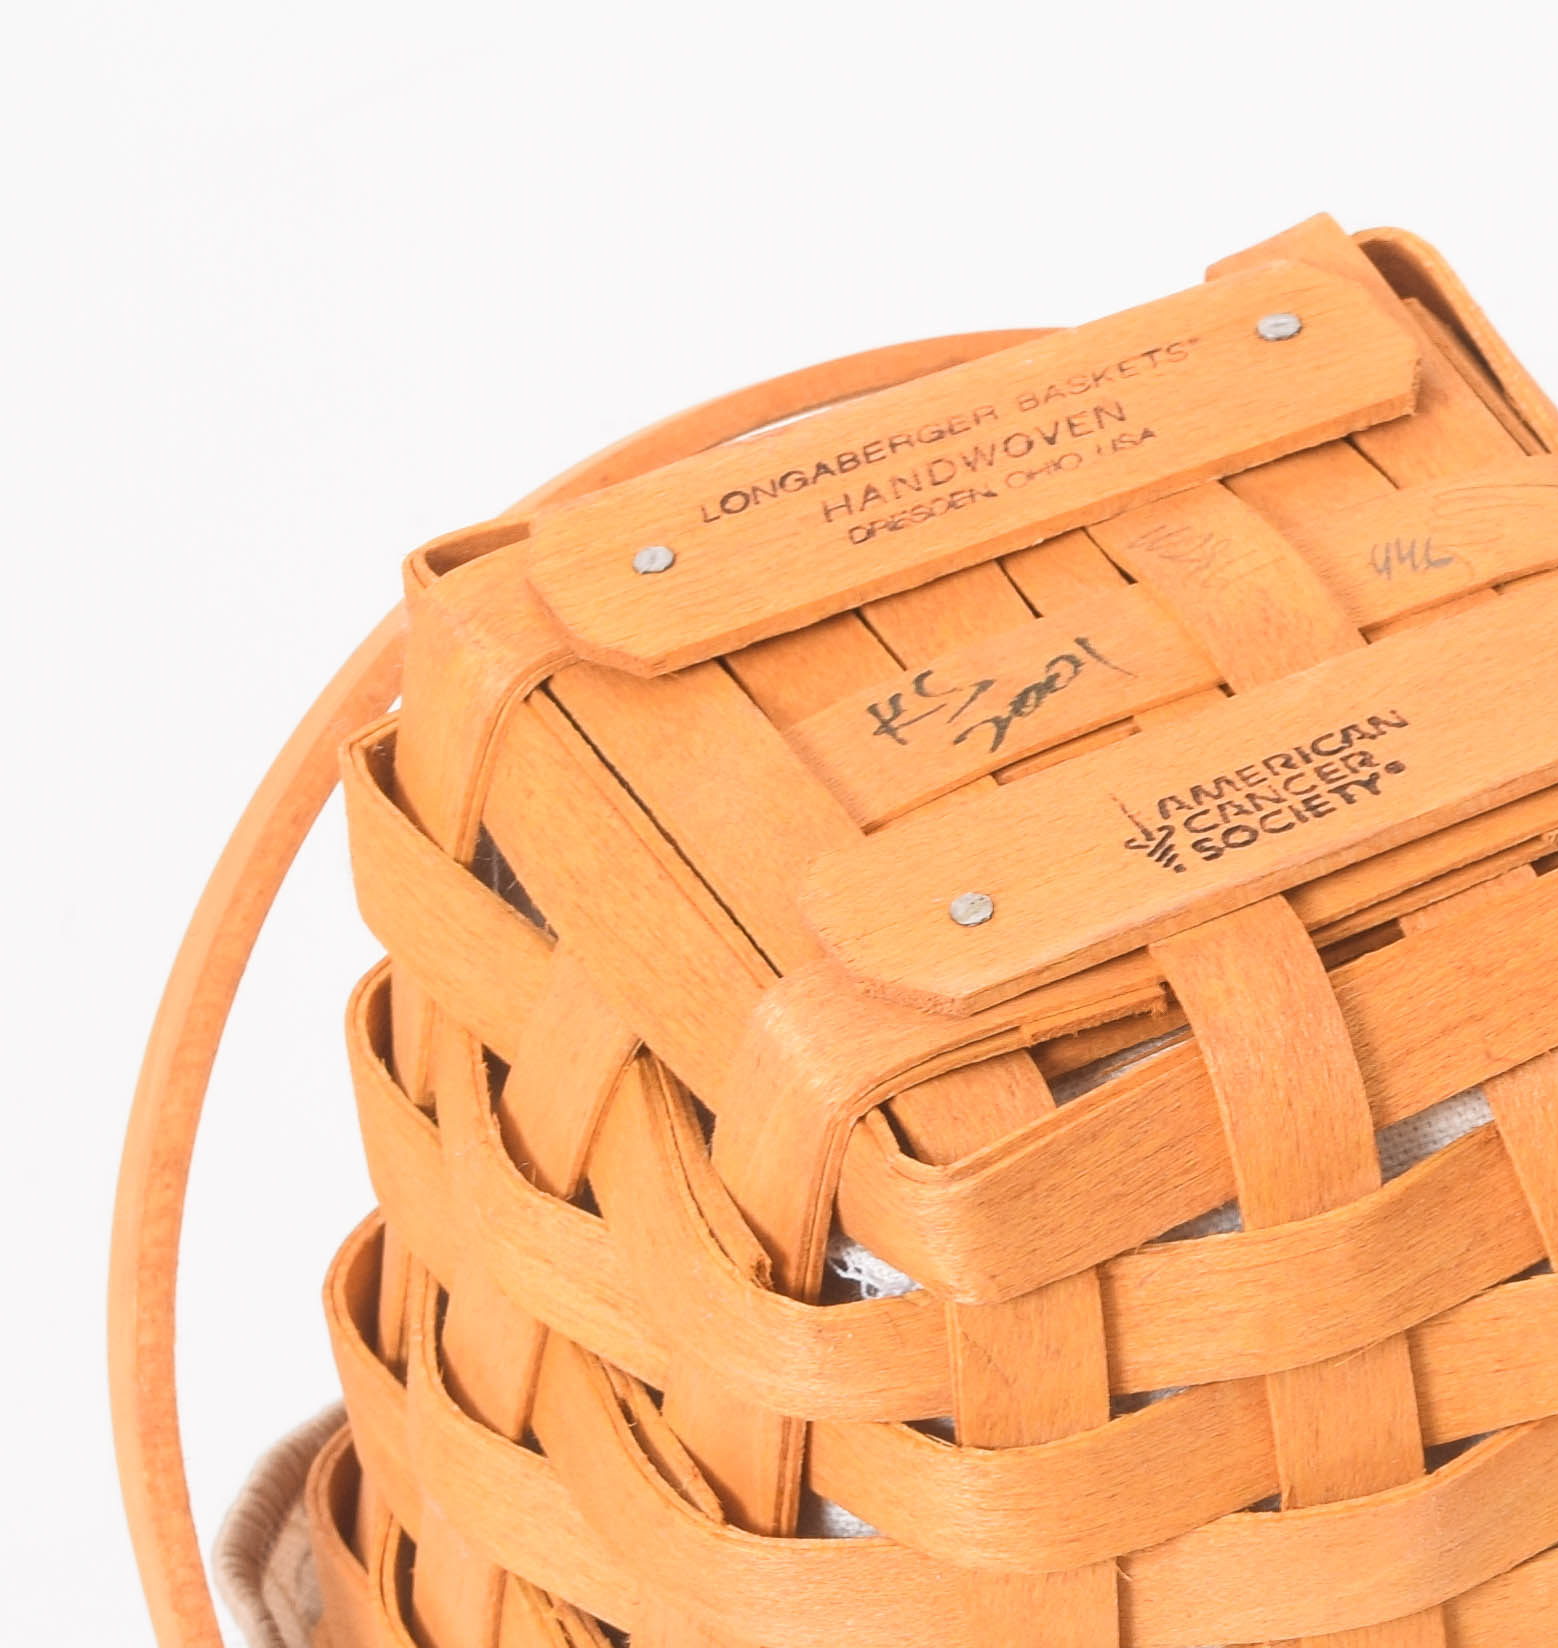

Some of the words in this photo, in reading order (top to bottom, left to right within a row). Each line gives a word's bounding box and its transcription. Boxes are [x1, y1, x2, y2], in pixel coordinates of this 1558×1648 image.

[701, 403, 1000, 523] LONGABERGER
[821, 400, 1127, 524] HANDWOVEN
[1156, 708, 1409, 820] AMERICAN
[1184, 749, 1380, 836] CANCER
[1190, 771, 1384, 862] SOCIETY
